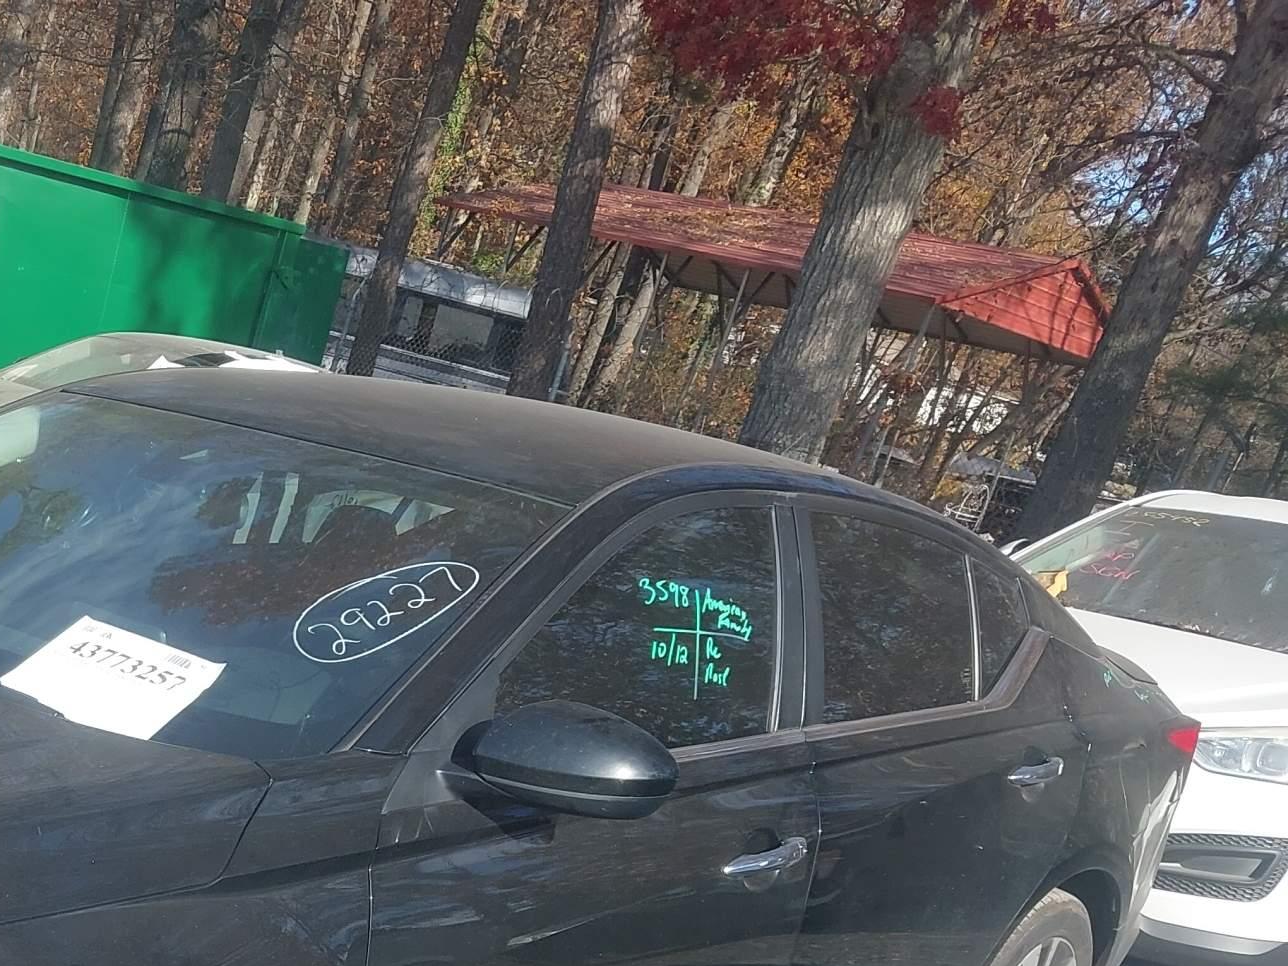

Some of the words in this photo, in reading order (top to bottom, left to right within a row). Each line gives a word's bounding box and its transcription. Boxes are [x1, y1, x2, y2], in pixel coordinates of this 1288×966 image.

[307, 566, 463, 656] 29227
[639, 578, 690, 608] 3598
[69, 641, 187, 691] 43773257
[650, 633, 689, 667] 10/12
